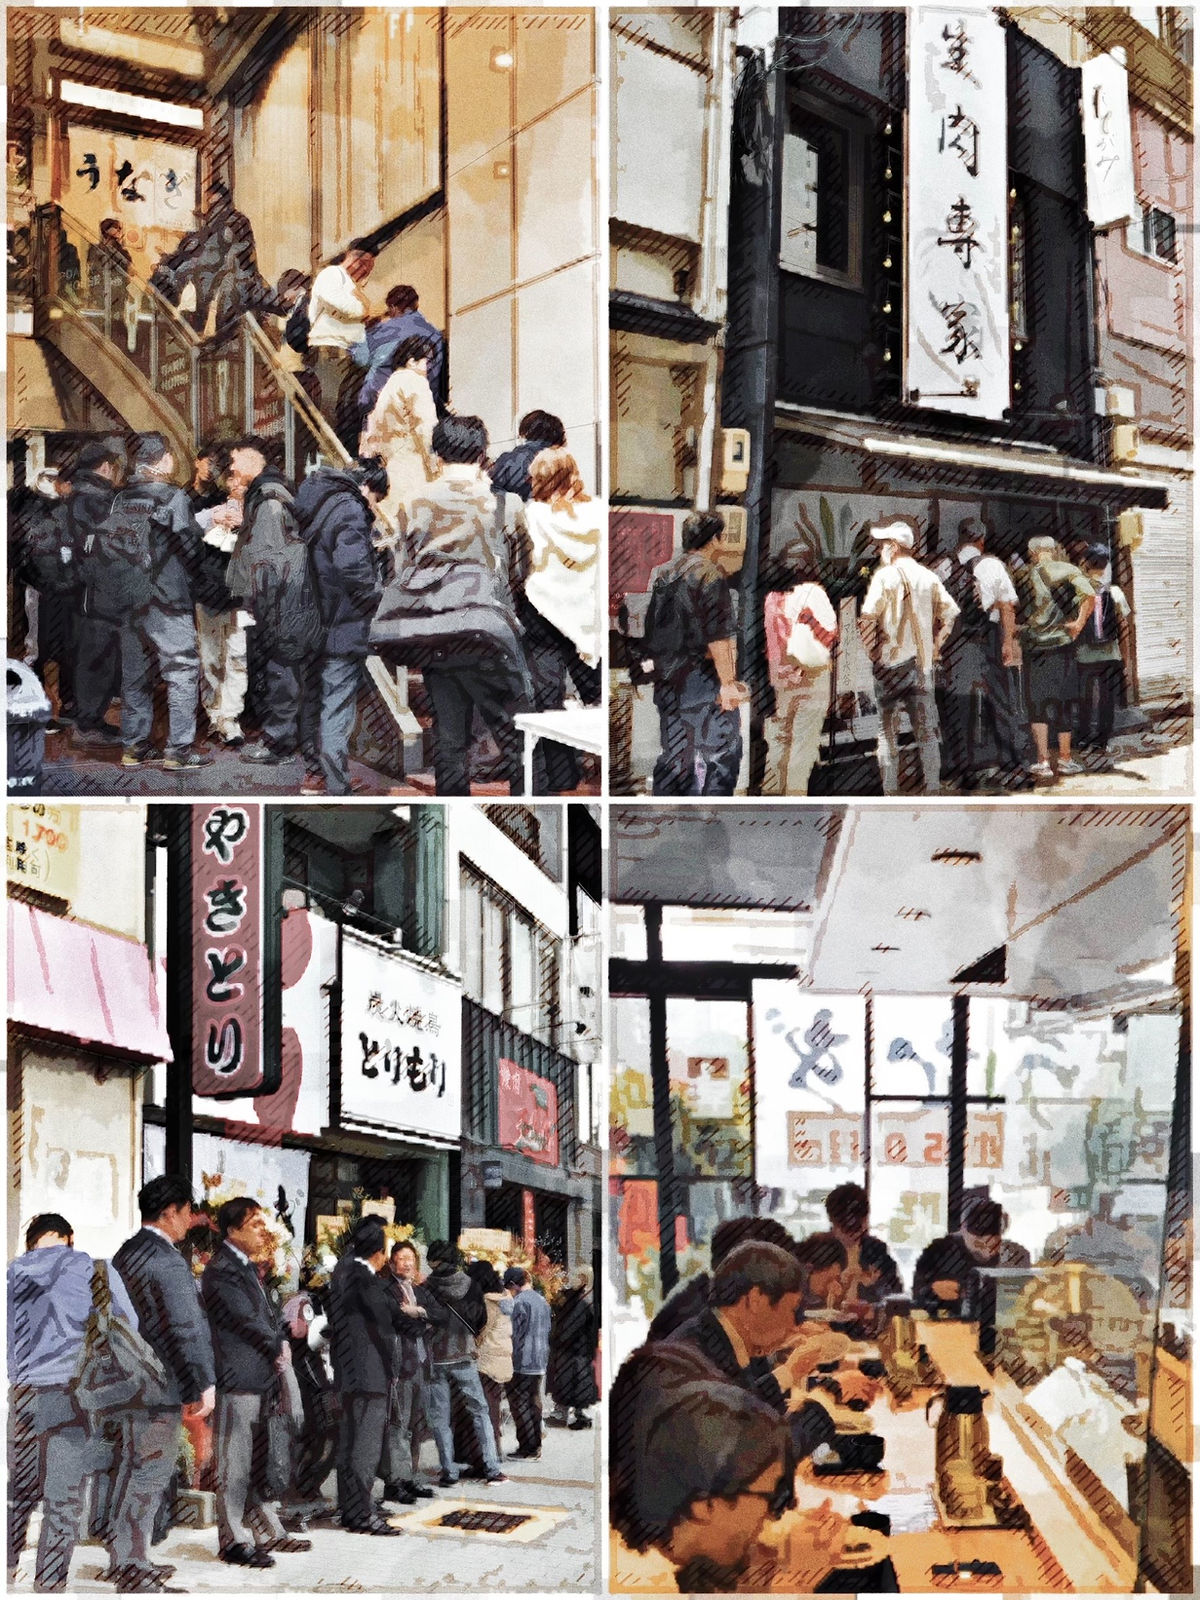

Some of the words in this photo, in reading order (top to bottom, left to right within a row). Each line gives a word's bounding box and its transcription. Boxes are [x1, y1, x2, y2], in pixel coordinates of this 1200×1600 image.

[76, 153, 191, 209] うなぎ
[204, 806, 249, 1076] やきとり
[359, 1032, 446, 1098] とりもり
